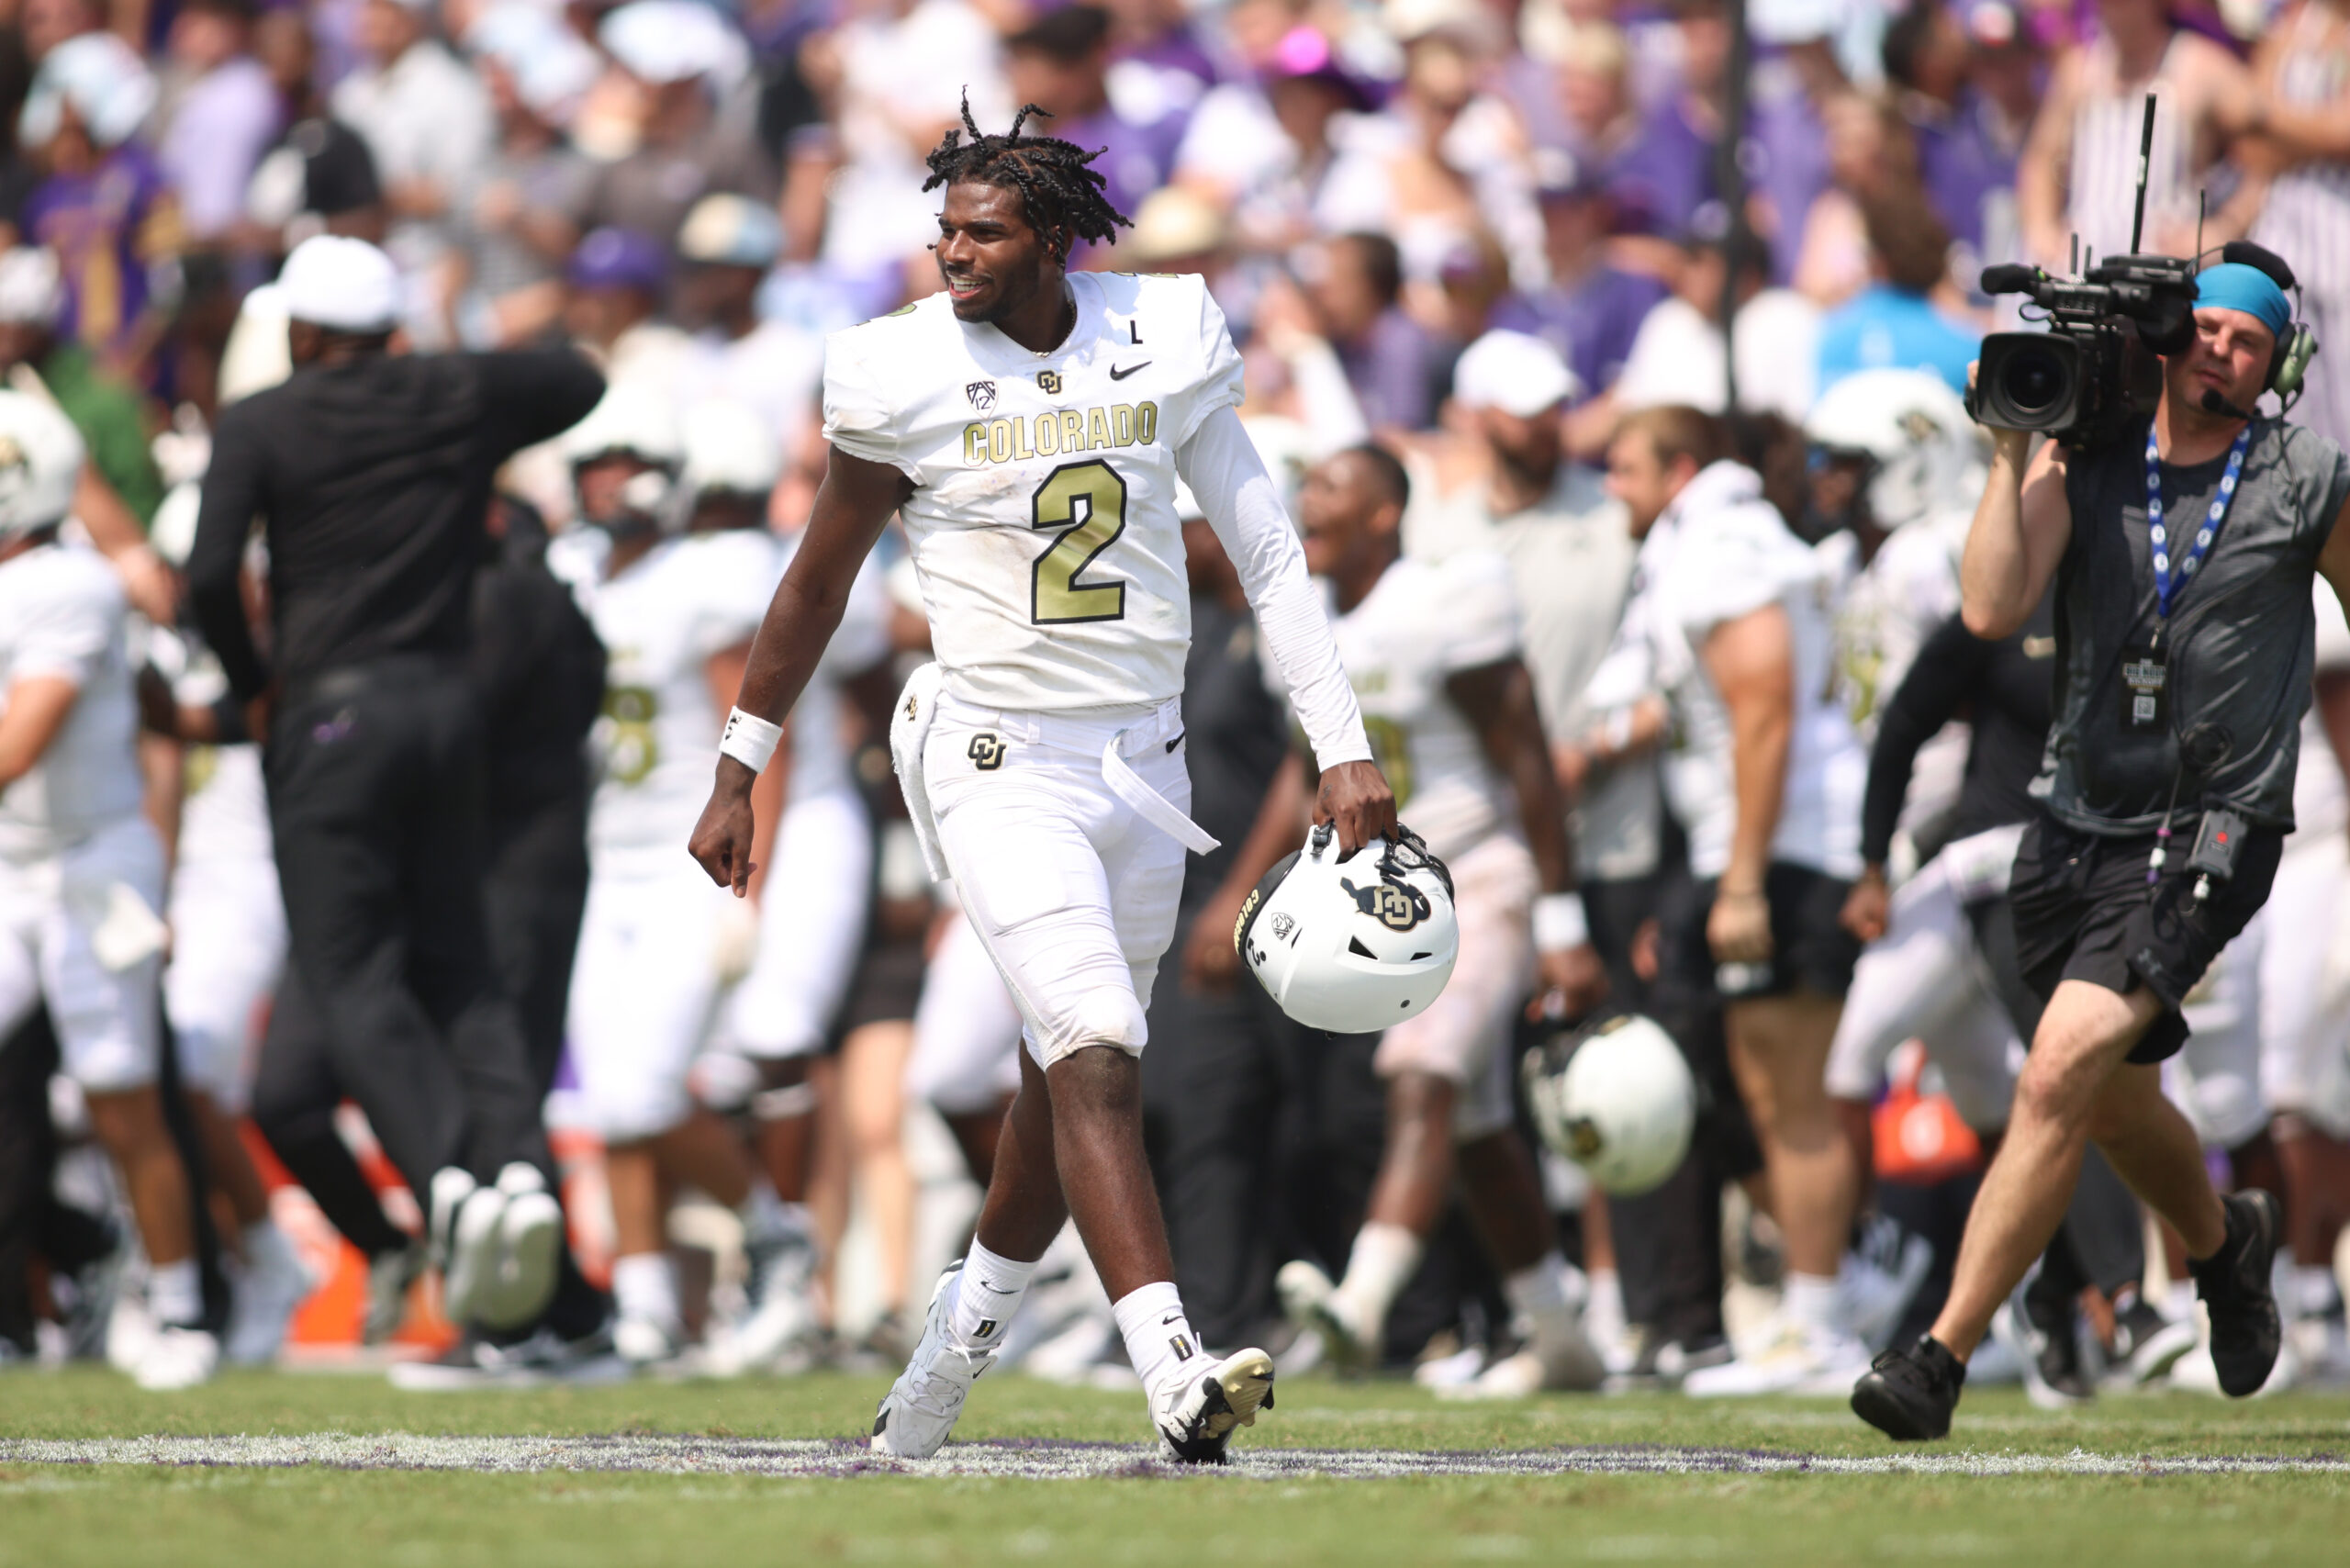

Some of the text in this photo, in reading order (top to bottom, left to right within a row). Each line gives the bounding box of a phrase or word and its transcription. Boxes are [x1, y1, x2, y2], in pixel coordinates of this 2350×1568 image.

[1129, 319, 1144, 344] L
[966, 380, 997, 404] PAC
[1036, 370, 1062, 395] CU
[975, 396, 991, 411] 12
[963, 400, 1158, 467] COLORADO
[1031, 458, 1127, 625] 2
[968, 733, 1007, 771] CU
